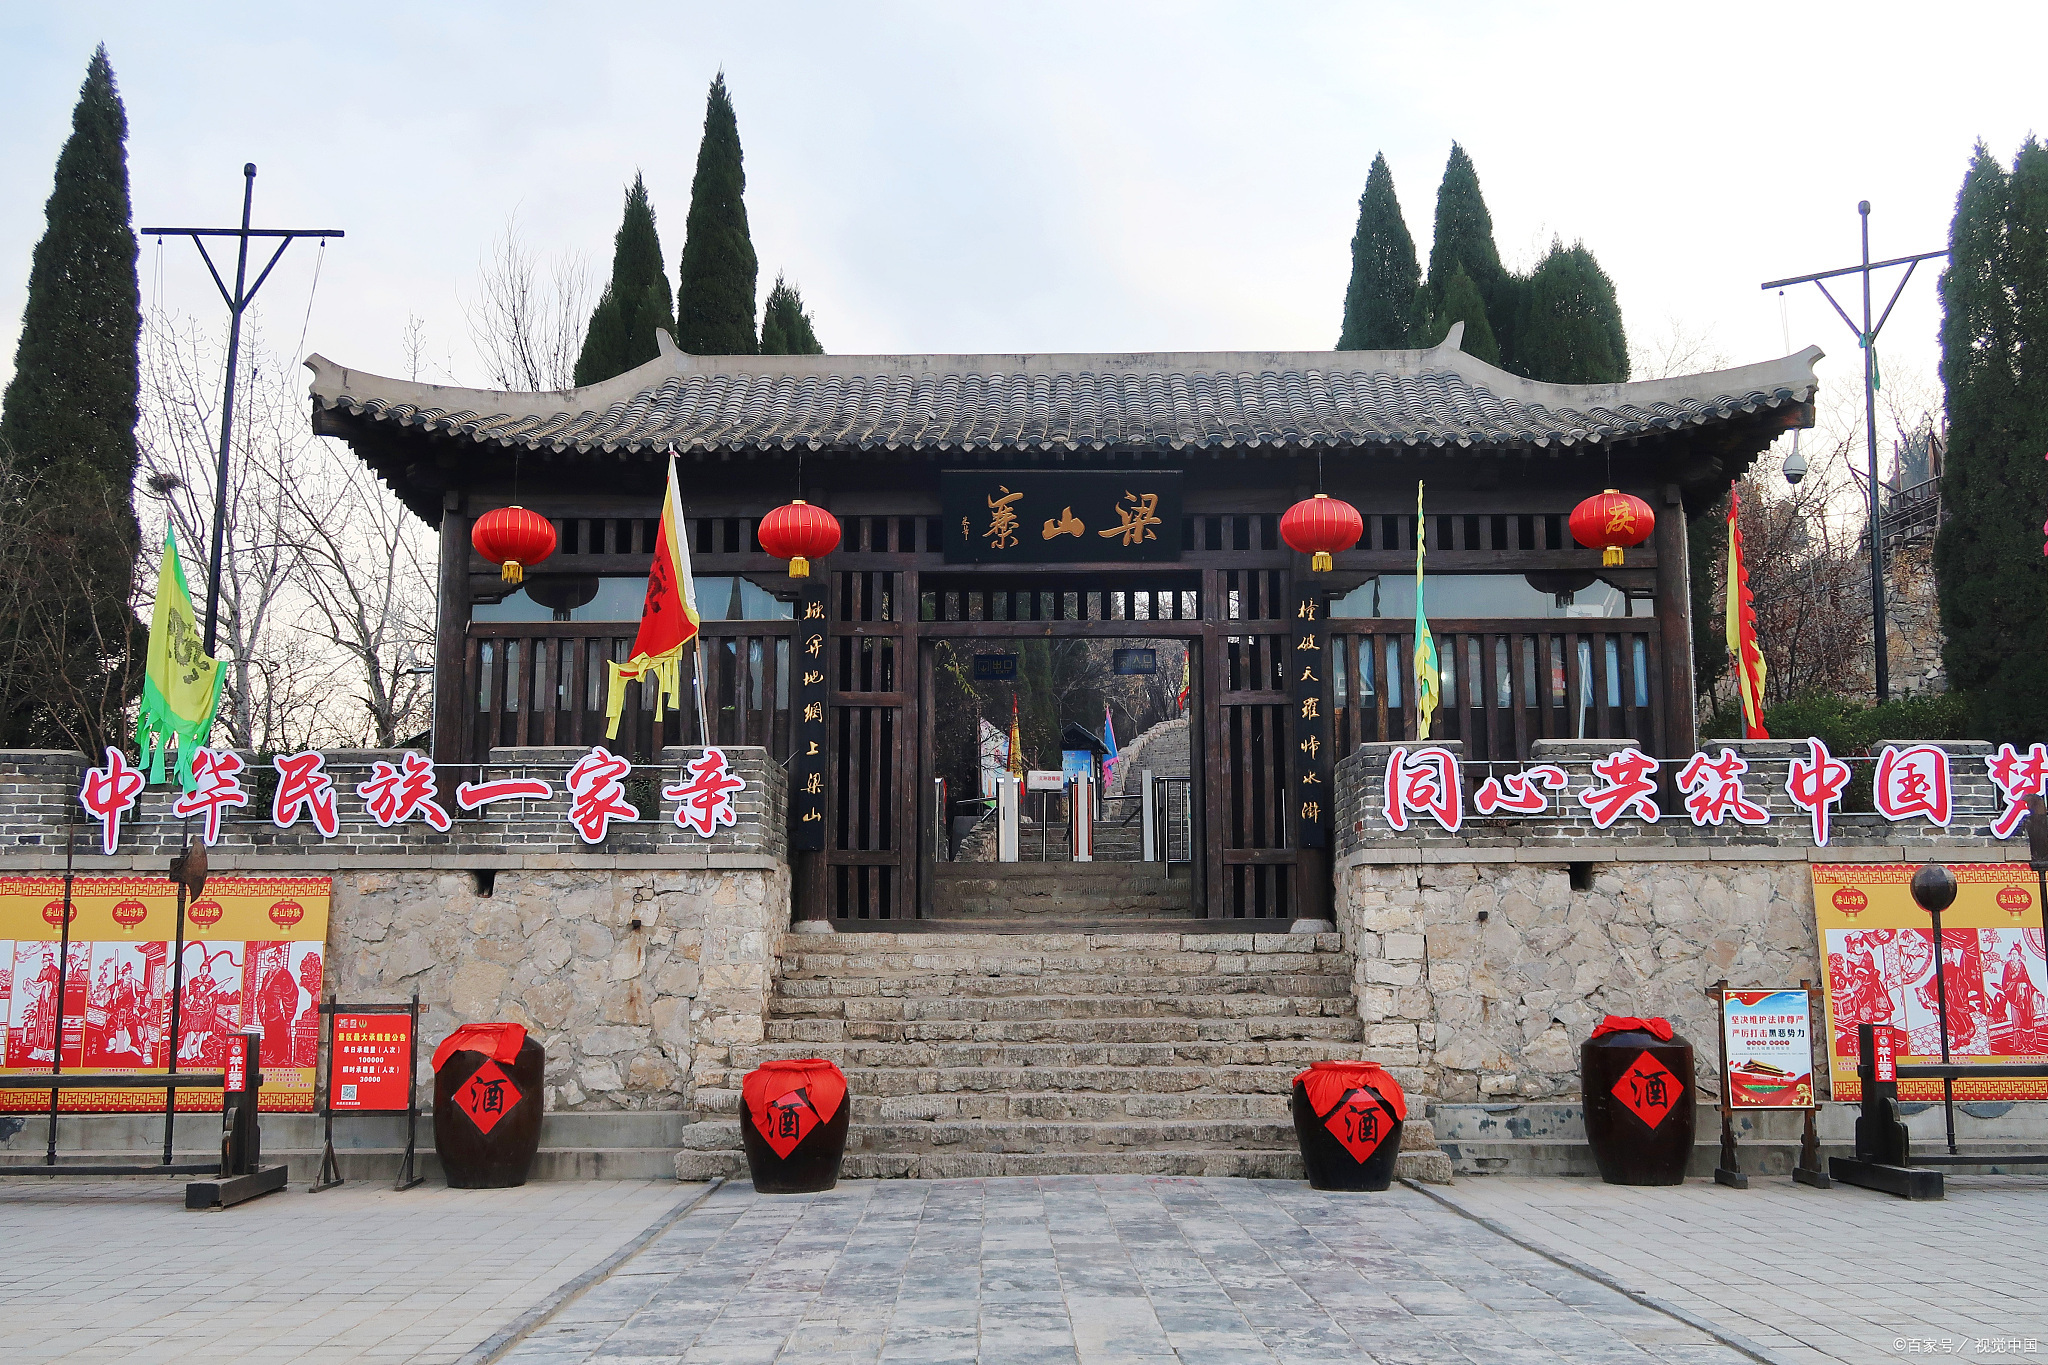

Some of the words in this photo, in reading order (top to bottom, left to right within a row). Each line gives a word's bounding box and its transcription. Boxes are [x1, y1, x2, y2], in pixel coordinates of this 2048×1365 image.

[982, 485, 1162, 549] 梁山寨
[992, 660, 1013, 669] 出口
[1132, 654, 1152, 664] 入口
[81, 747, 745, 854] 中华民族一家亲
[1383, 739, 2048, 845] 同心共筑中国梦
[338, 1032, 406, 1042] 景区最大承载量公告
[1731, 1015, 1804, 1024] 坚决维护法律尊严
[1732, 1028, 1805, 1038] 严厉打击黑恶势力
[228, 1056, 243, 1090] 禁止攀登
[1877, 1046, 1893, 1080] 禁止攀登
[470, 1076, 504, 1115] 酒
[1630, 1069, 1668, 1109] 酒
[768, 1102, 803, 1141] 酒
[1345, 1105, 1380, 1145] 酒
